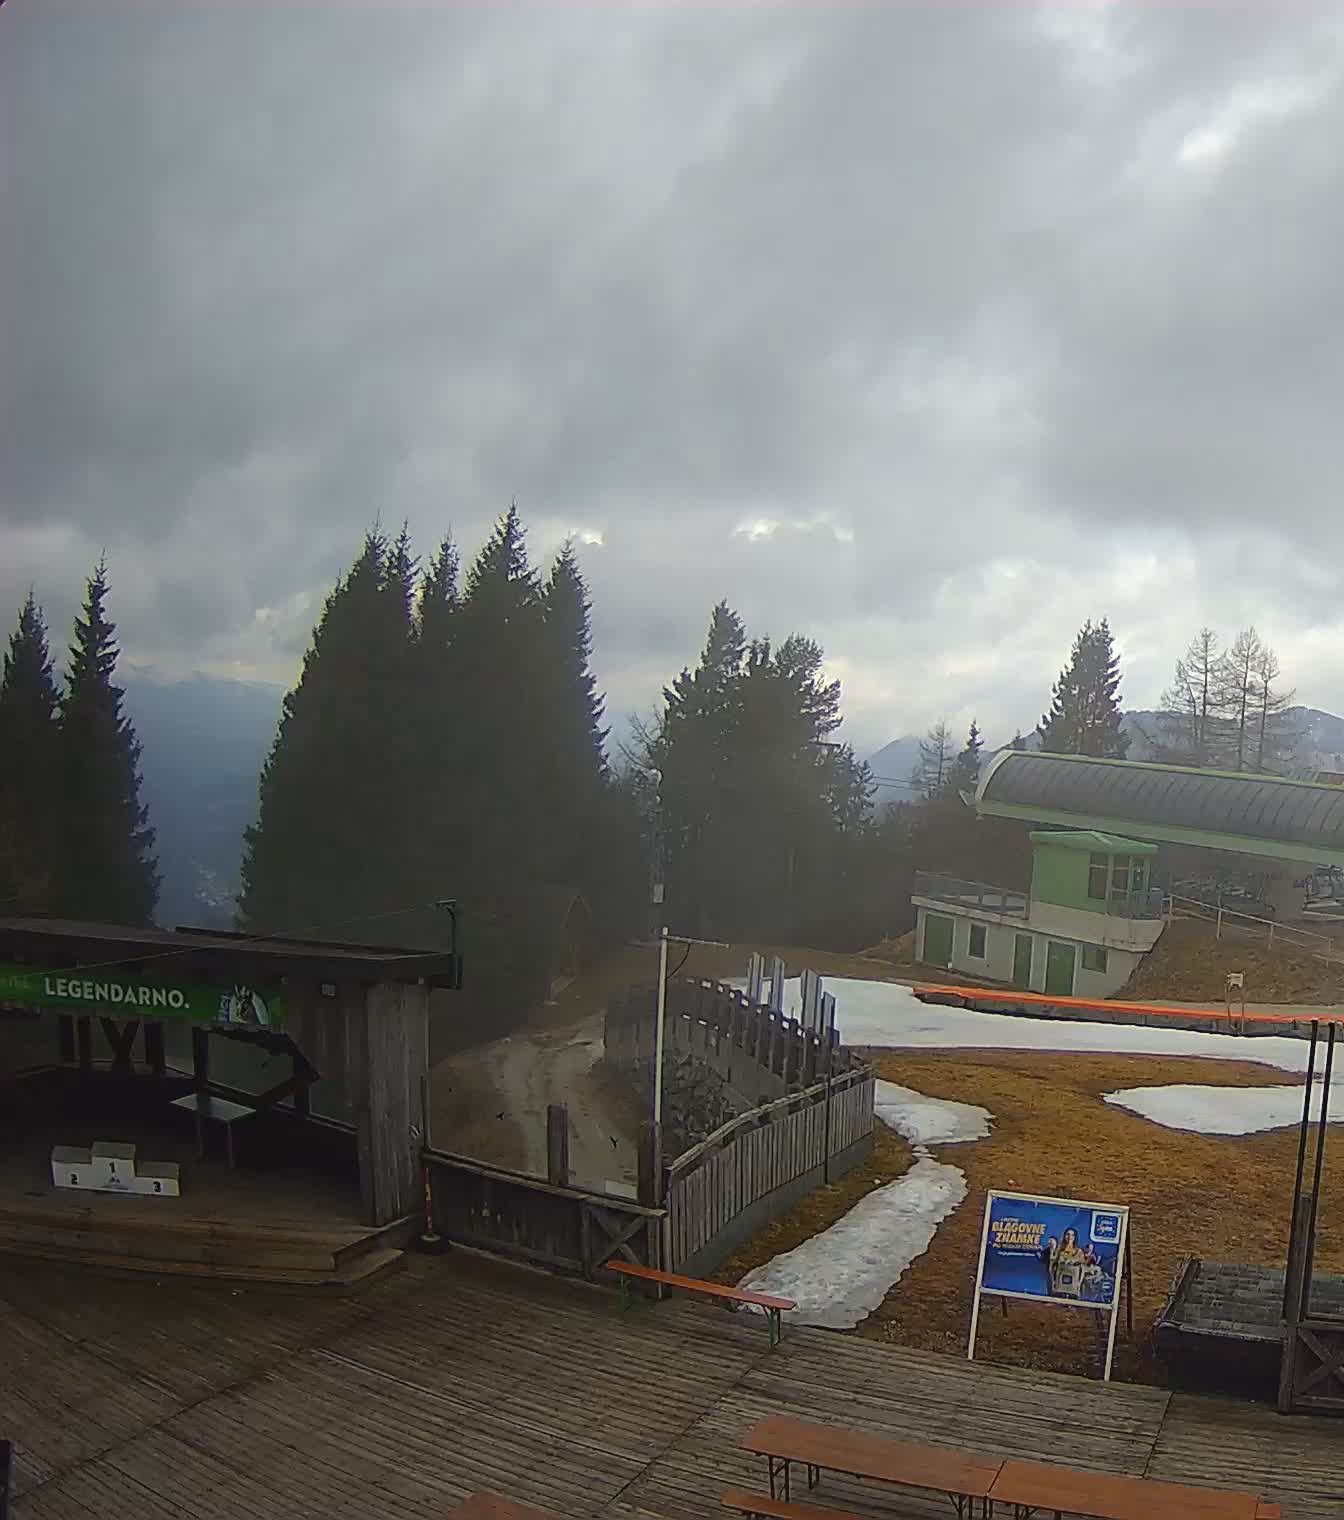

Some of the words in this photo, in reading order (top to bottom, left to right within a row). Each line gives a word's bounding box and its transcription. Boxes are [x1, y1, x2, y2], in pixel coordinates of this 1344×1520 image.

[44, 976, 191, 1010] LEGENDARNO.
[109, 1161, 116, 1174] 1
[69, 1173, 78, 1186] 2
[152, 1180, 162, 1193] 3
